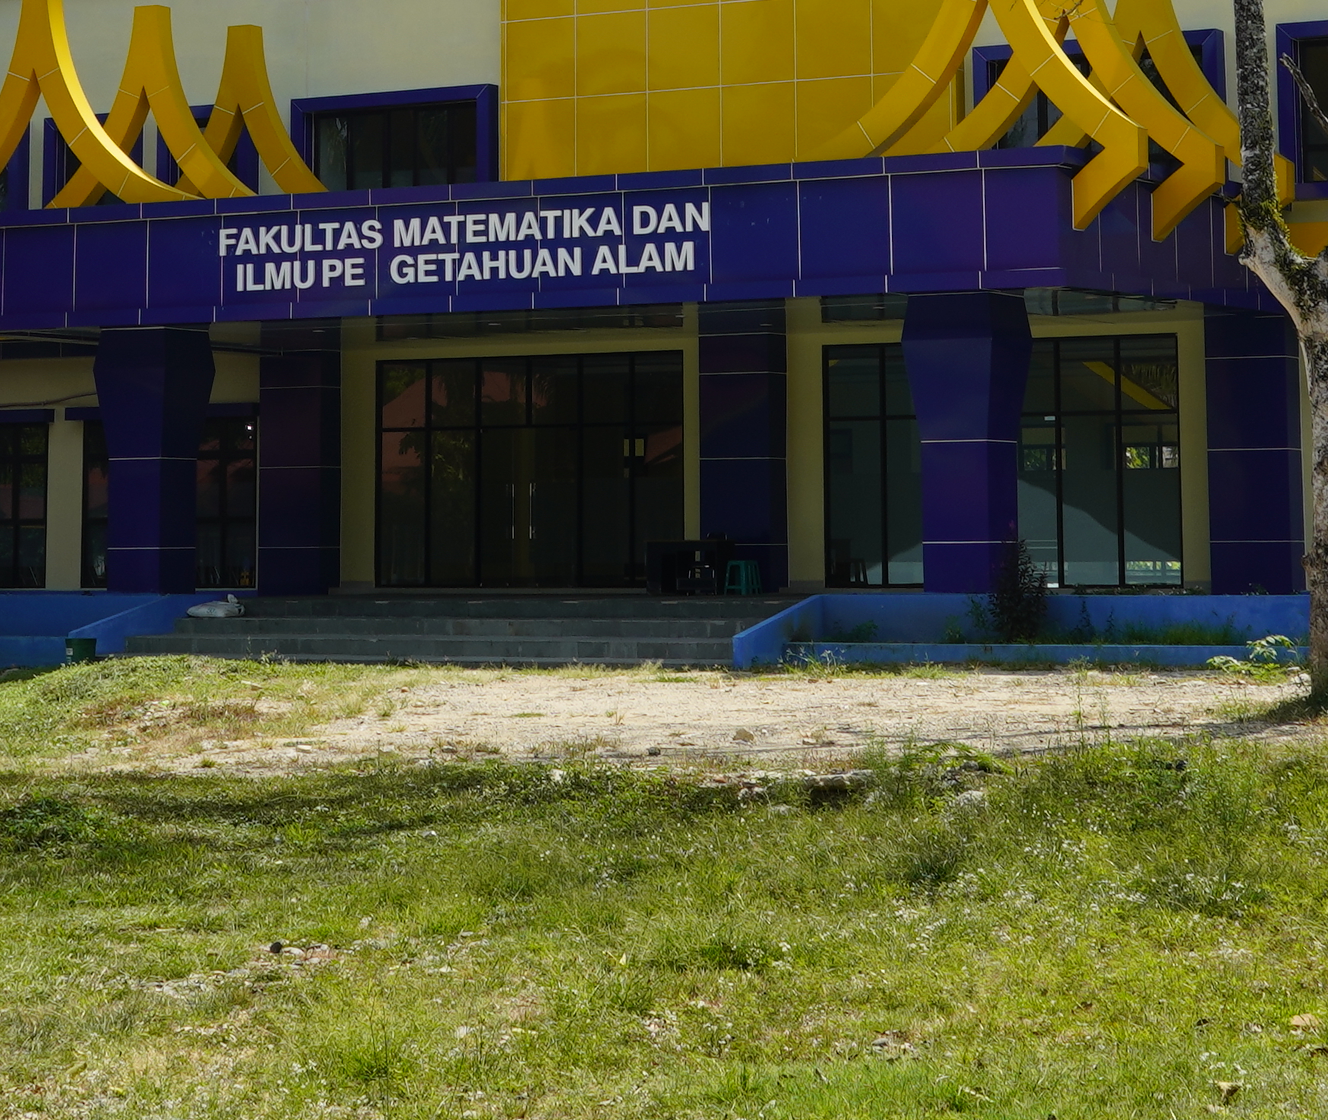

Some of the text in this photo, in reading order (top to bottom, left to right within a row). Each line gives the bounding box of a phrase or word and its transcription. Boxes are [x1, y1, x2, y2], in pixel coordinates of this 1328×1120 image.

[219, 201, 711, 257] FAKULTAS MATEMATIKA DAN
[236, 241, 695, 292] ILMU PE GETAHUAN ALAM
